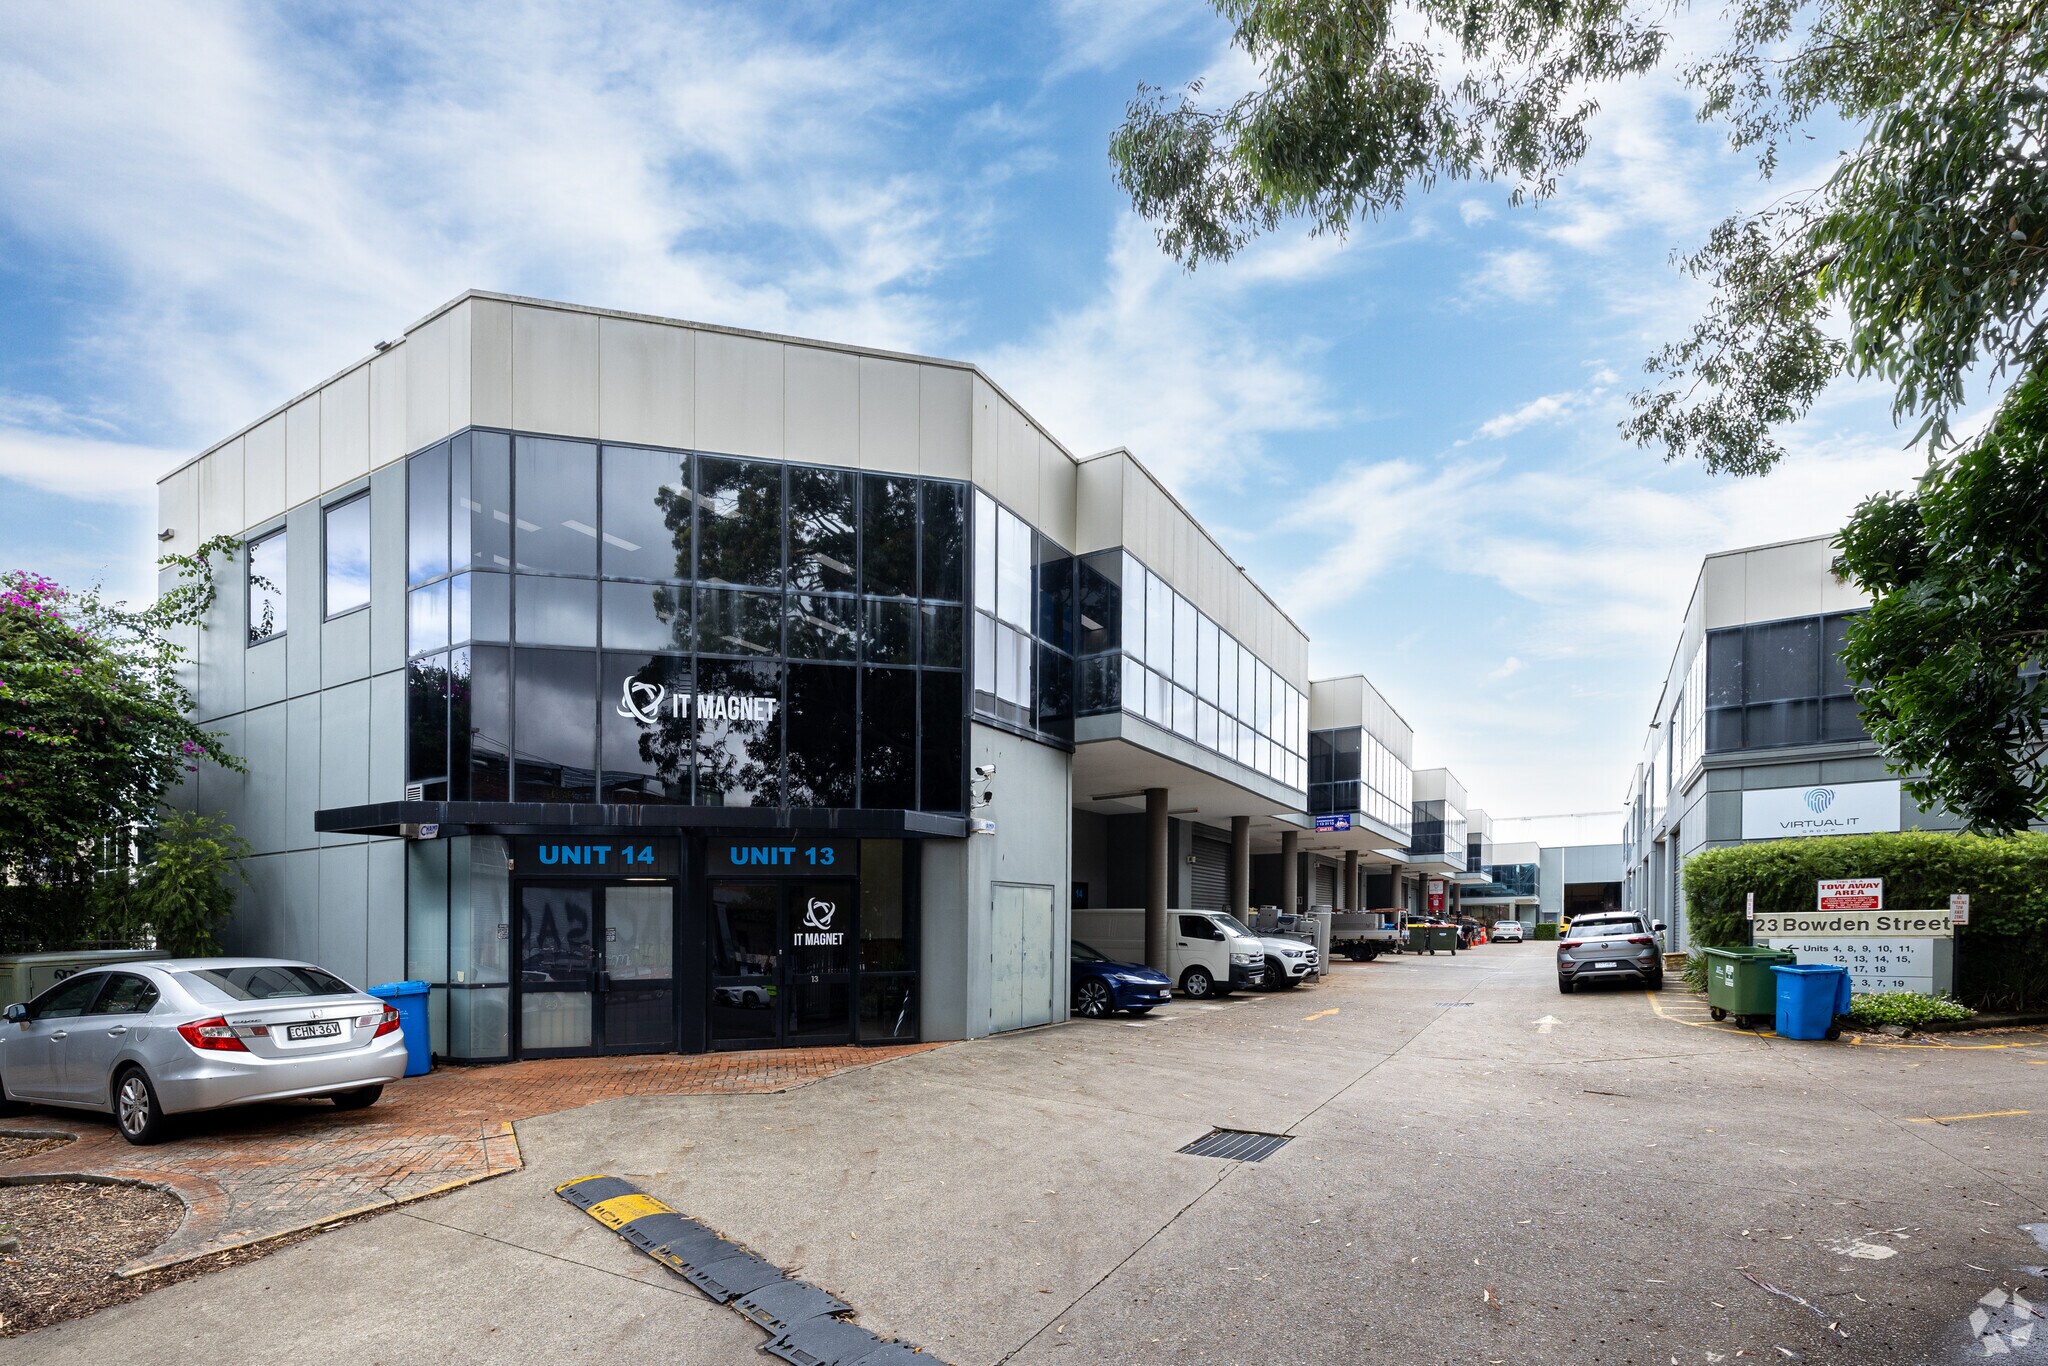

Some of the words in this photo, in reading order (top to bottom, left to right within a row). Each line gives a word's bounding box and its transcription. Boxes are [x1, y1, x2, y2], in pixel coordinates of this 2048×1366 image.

[673, 694, 691, 718] IT
[697, 695, 777, 721] MAGNET
[1780, 819, 1844, 829] VIRTUAL
[1846, 817, 1860, 825] IT
[539, 845, 612, 865] UNIT
[621, 845, 655, 865] 14
[730, 846, 796, 865] UNIT
[805, 846, 835, 865] 13
[1755, 918, 1779, 932] 23
[1783, 917, 1870, 931] Bowden
[1876, 916, 1951, 931] Street
[793, 933, 804, 946] IT
[805, 932, 844, 946] MAGNET
[1832, 945, 1842, 953] 4,
[1847, 945, 1857, 953] 8,
[1862, 945, 1871, 953] 9,
[1877, 945, 1892, 953] 10,
[1899, 945, 1914, 953] 11,
[1833, 955, 1847, 963] 12,
[1854, 955, 1868, 963] 13,
[1874, 955, 1889, 963] 14,
[1895, 955, 1911, 964] 15,
[1874, 965, 1887, 973] 18
[811, 975, 819, 983] 13
